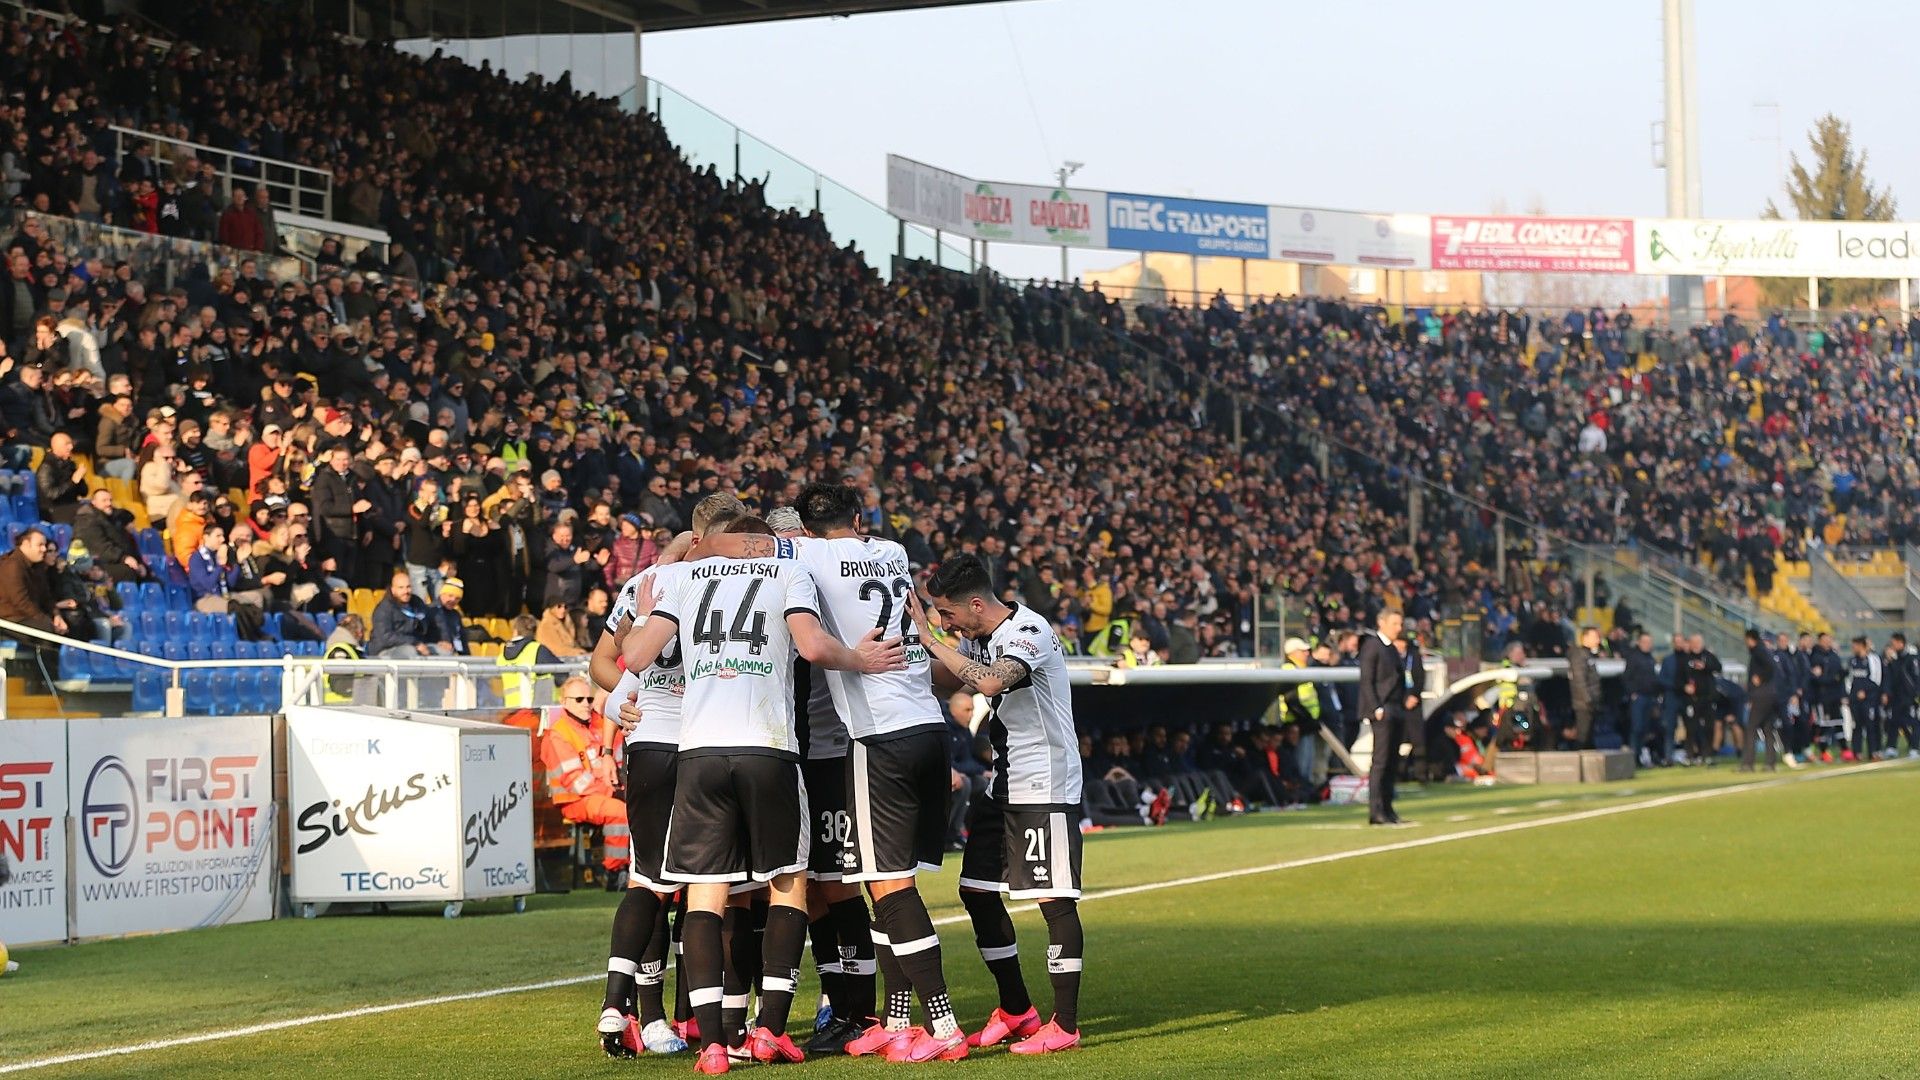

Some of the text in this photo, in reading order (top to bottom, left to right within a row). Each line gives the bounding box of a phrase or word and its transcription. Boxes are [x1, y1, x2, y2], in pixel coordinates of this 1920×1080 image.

[1110, 199, 1165, 232] MEC
[1479, 221, 1515, 244] EDIL
[692, 563, 779, 580] KULUSEVSKI
[841, 561, 885, 577] BRUNO
[693, 578, 769, 655] 44
[644, 671, 666, 689] Viva
[691, 660, 713, 680] Viva
[146, 756, 258, 802] FIRST
[146, 806, 257, 853] POINT
[821, 810, 846, 843] 36
[843, 815, 855, 847] 2
[1025, 828, 1045, 861] 21
[145, 860, 192, 875] SOLUZIONI
[83, 871, 257, 902] WWW.FIRSTPOINT.IT
